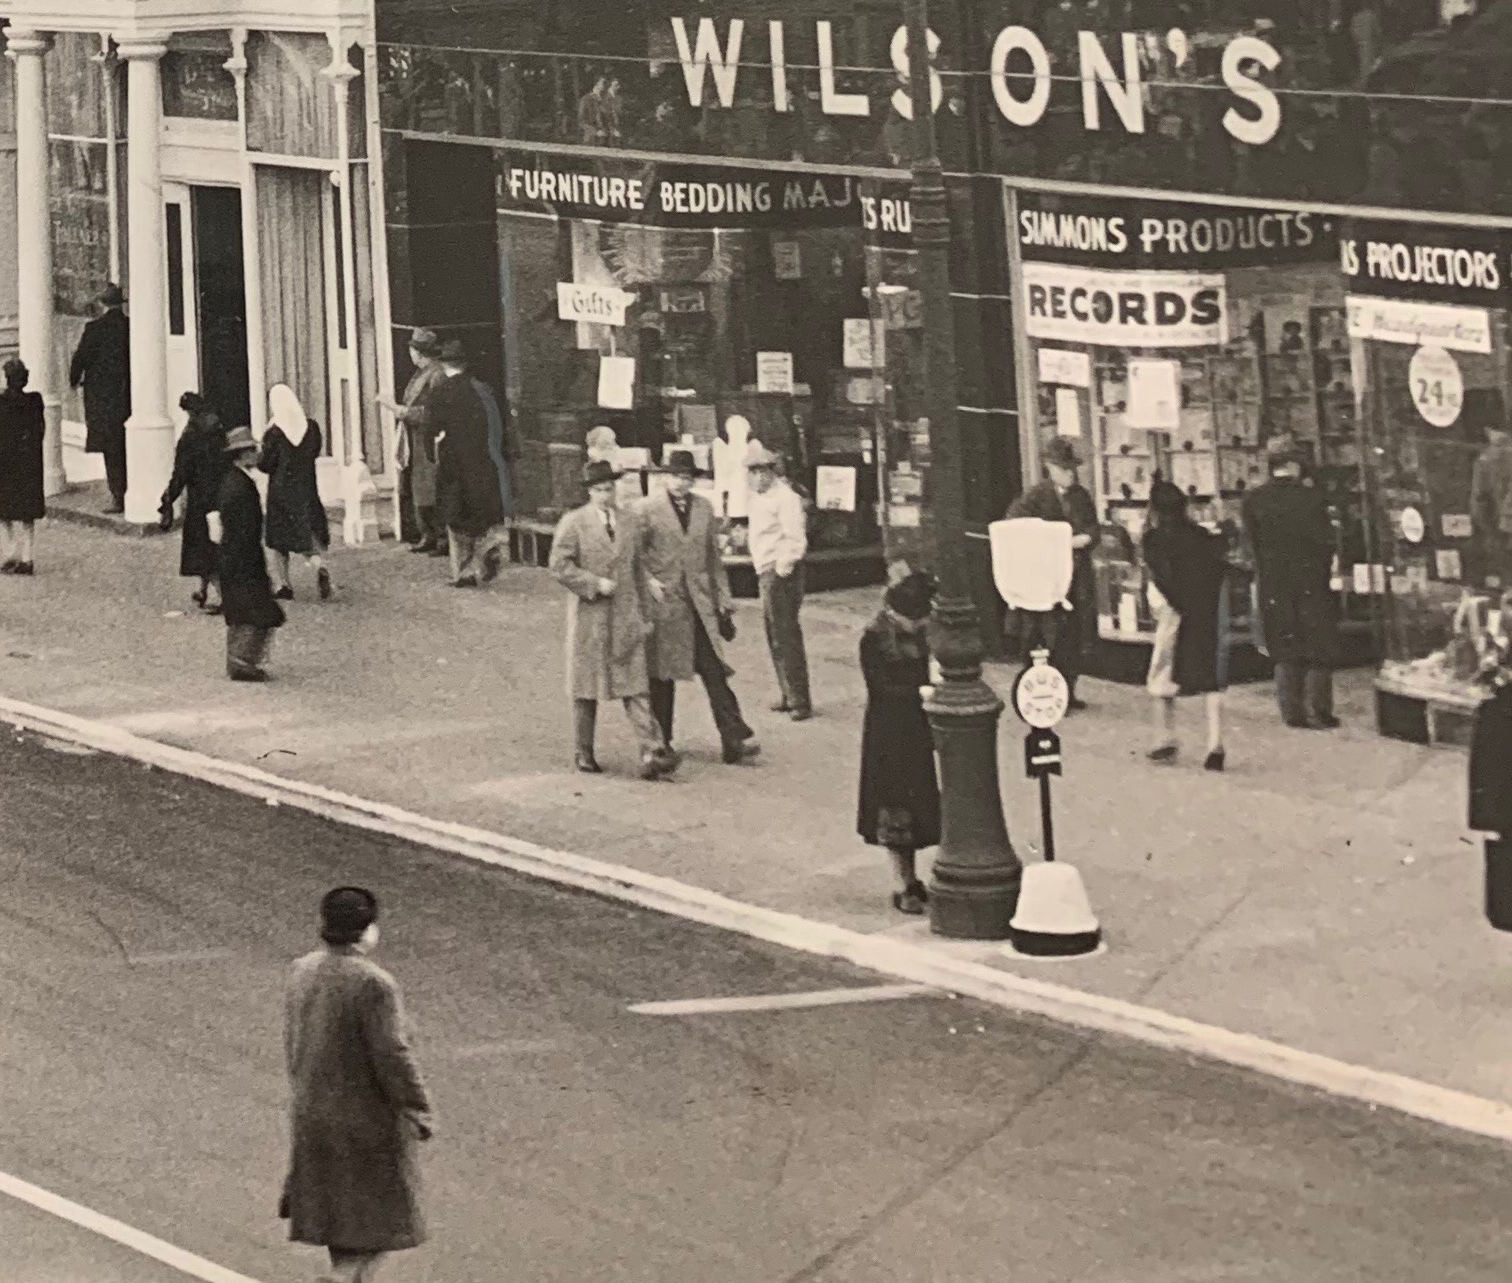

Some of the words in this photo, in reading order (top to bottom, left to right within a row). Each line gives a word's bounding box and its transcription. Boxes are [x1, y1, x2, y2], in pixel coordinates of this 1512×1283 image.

[671, 16, 1283, 145] WILSON'S
[510, 167, 645, 211] FURNITURE
[660, 180, 772, 214] BEDDING
[1020, 209, 1128, 255] SIMMONS
[1139, 213, 1313, 255] PRODUCTS
[1366, 241, 1501, 291] PROJECTORS
[1028, 283, 1222, 326] RECORDS
